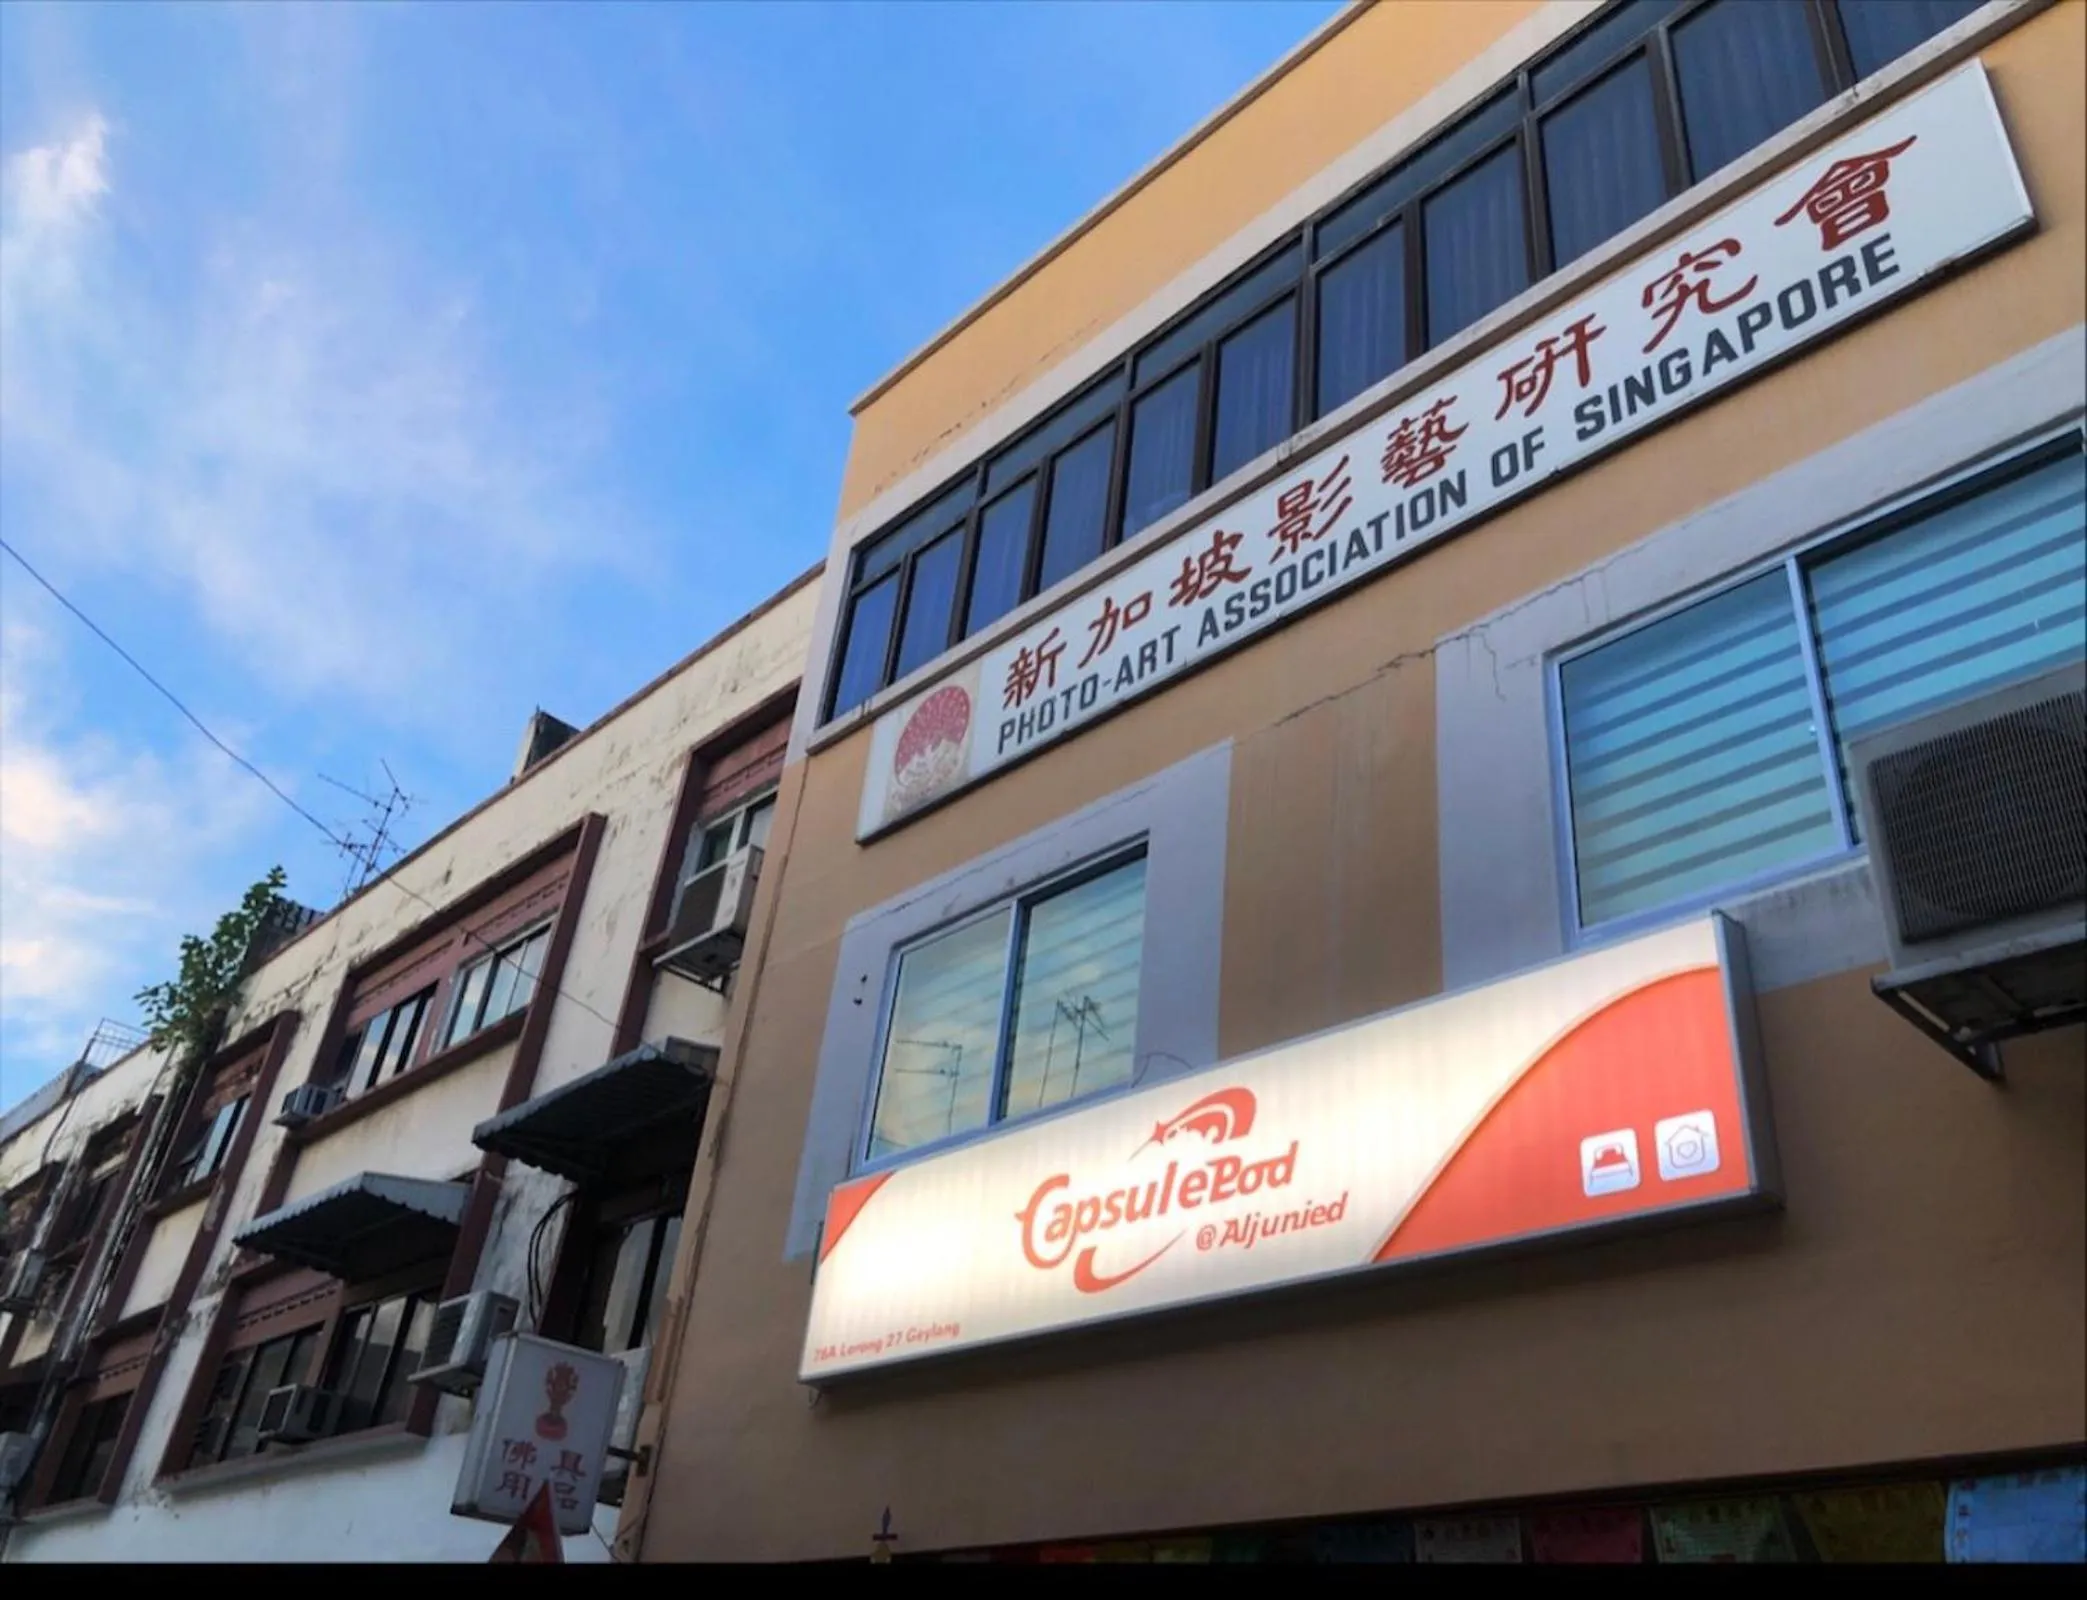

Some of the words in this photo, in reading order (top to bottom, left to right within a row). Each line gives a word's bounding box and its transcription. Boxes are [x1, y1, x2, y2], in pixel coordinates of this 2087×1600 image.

[997, 626, 1183, 755] PHOTO-ART
[1197, 469, 1469, 646] ASSOCIATION
[1490, 426, 1545, 488] OF
[1573, 233, 1901, 443] SINGAPORE
[1014, 1140, 1299, 1293] CapsulePod
[885, 1332, 903, 1349] 27
[905, 1321, 961, 1343] Geylang
